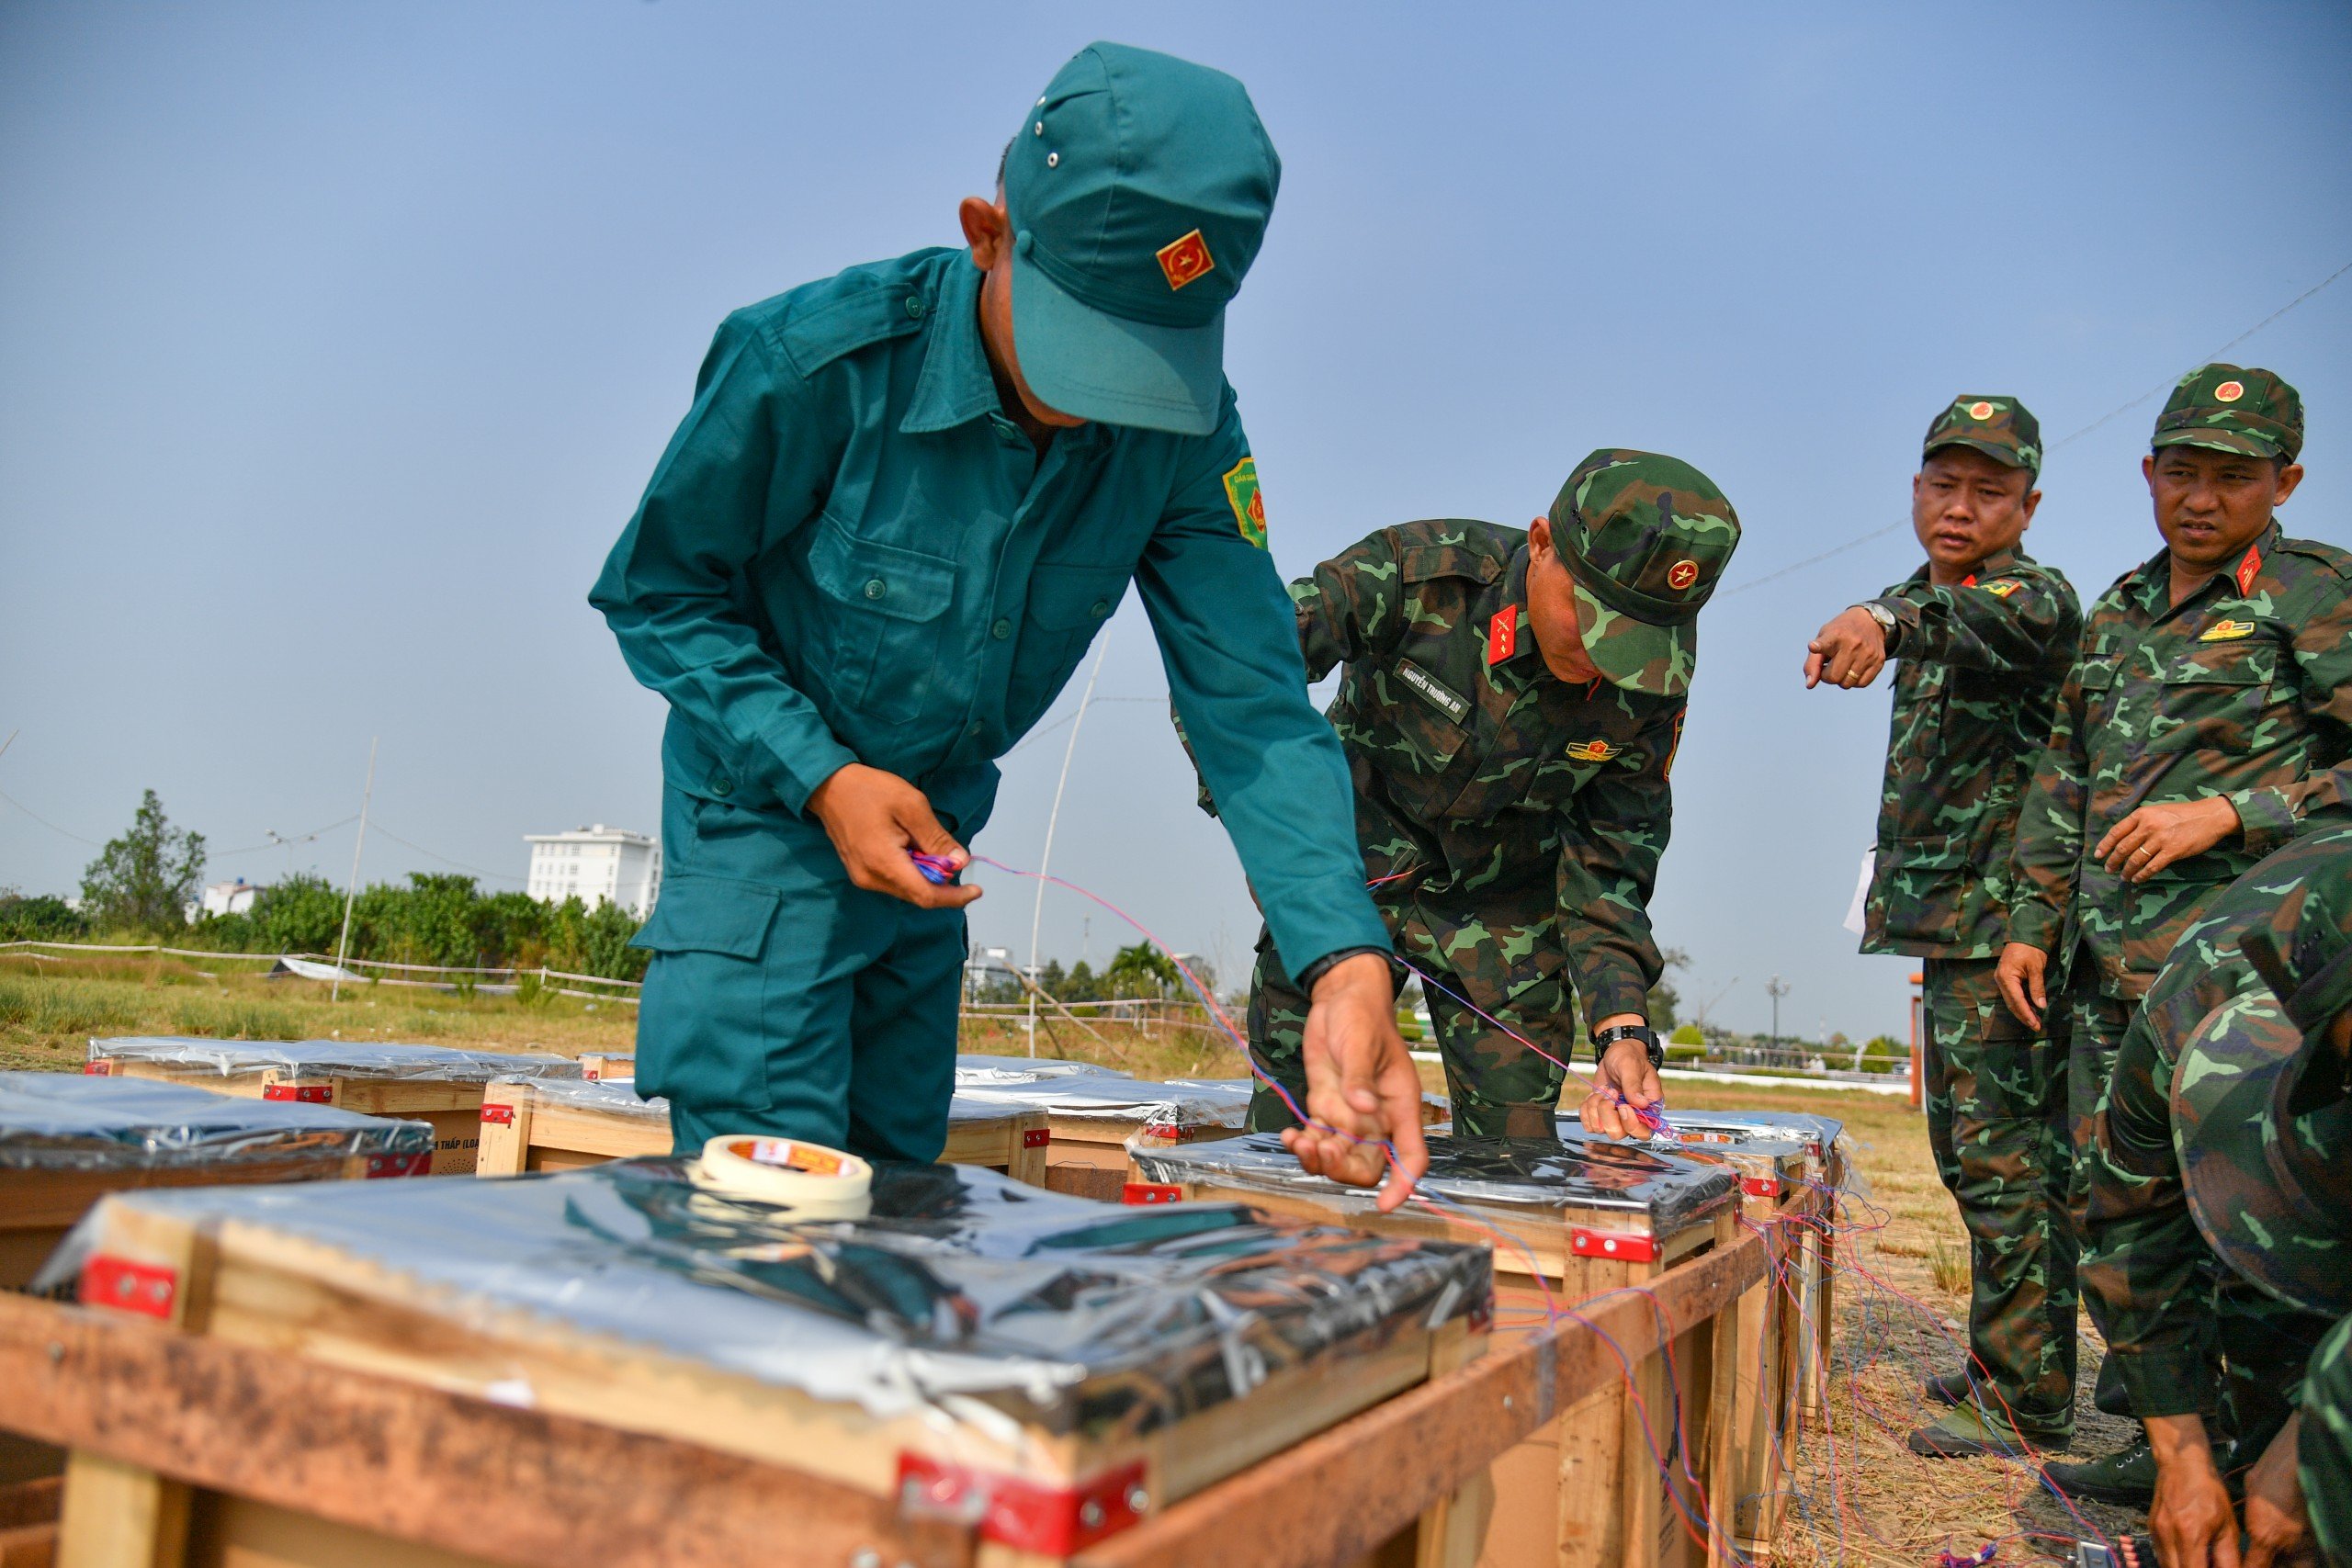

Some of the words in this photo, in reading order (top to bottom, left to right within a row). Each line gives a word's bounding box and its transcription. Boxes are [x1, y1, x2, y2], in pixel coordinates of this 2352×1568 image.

[1402, 667, 1429, 690] NGUYỄN
[1448, 700, 1461, 714] AN
[441, 1136, 461, 1150] THẤP
